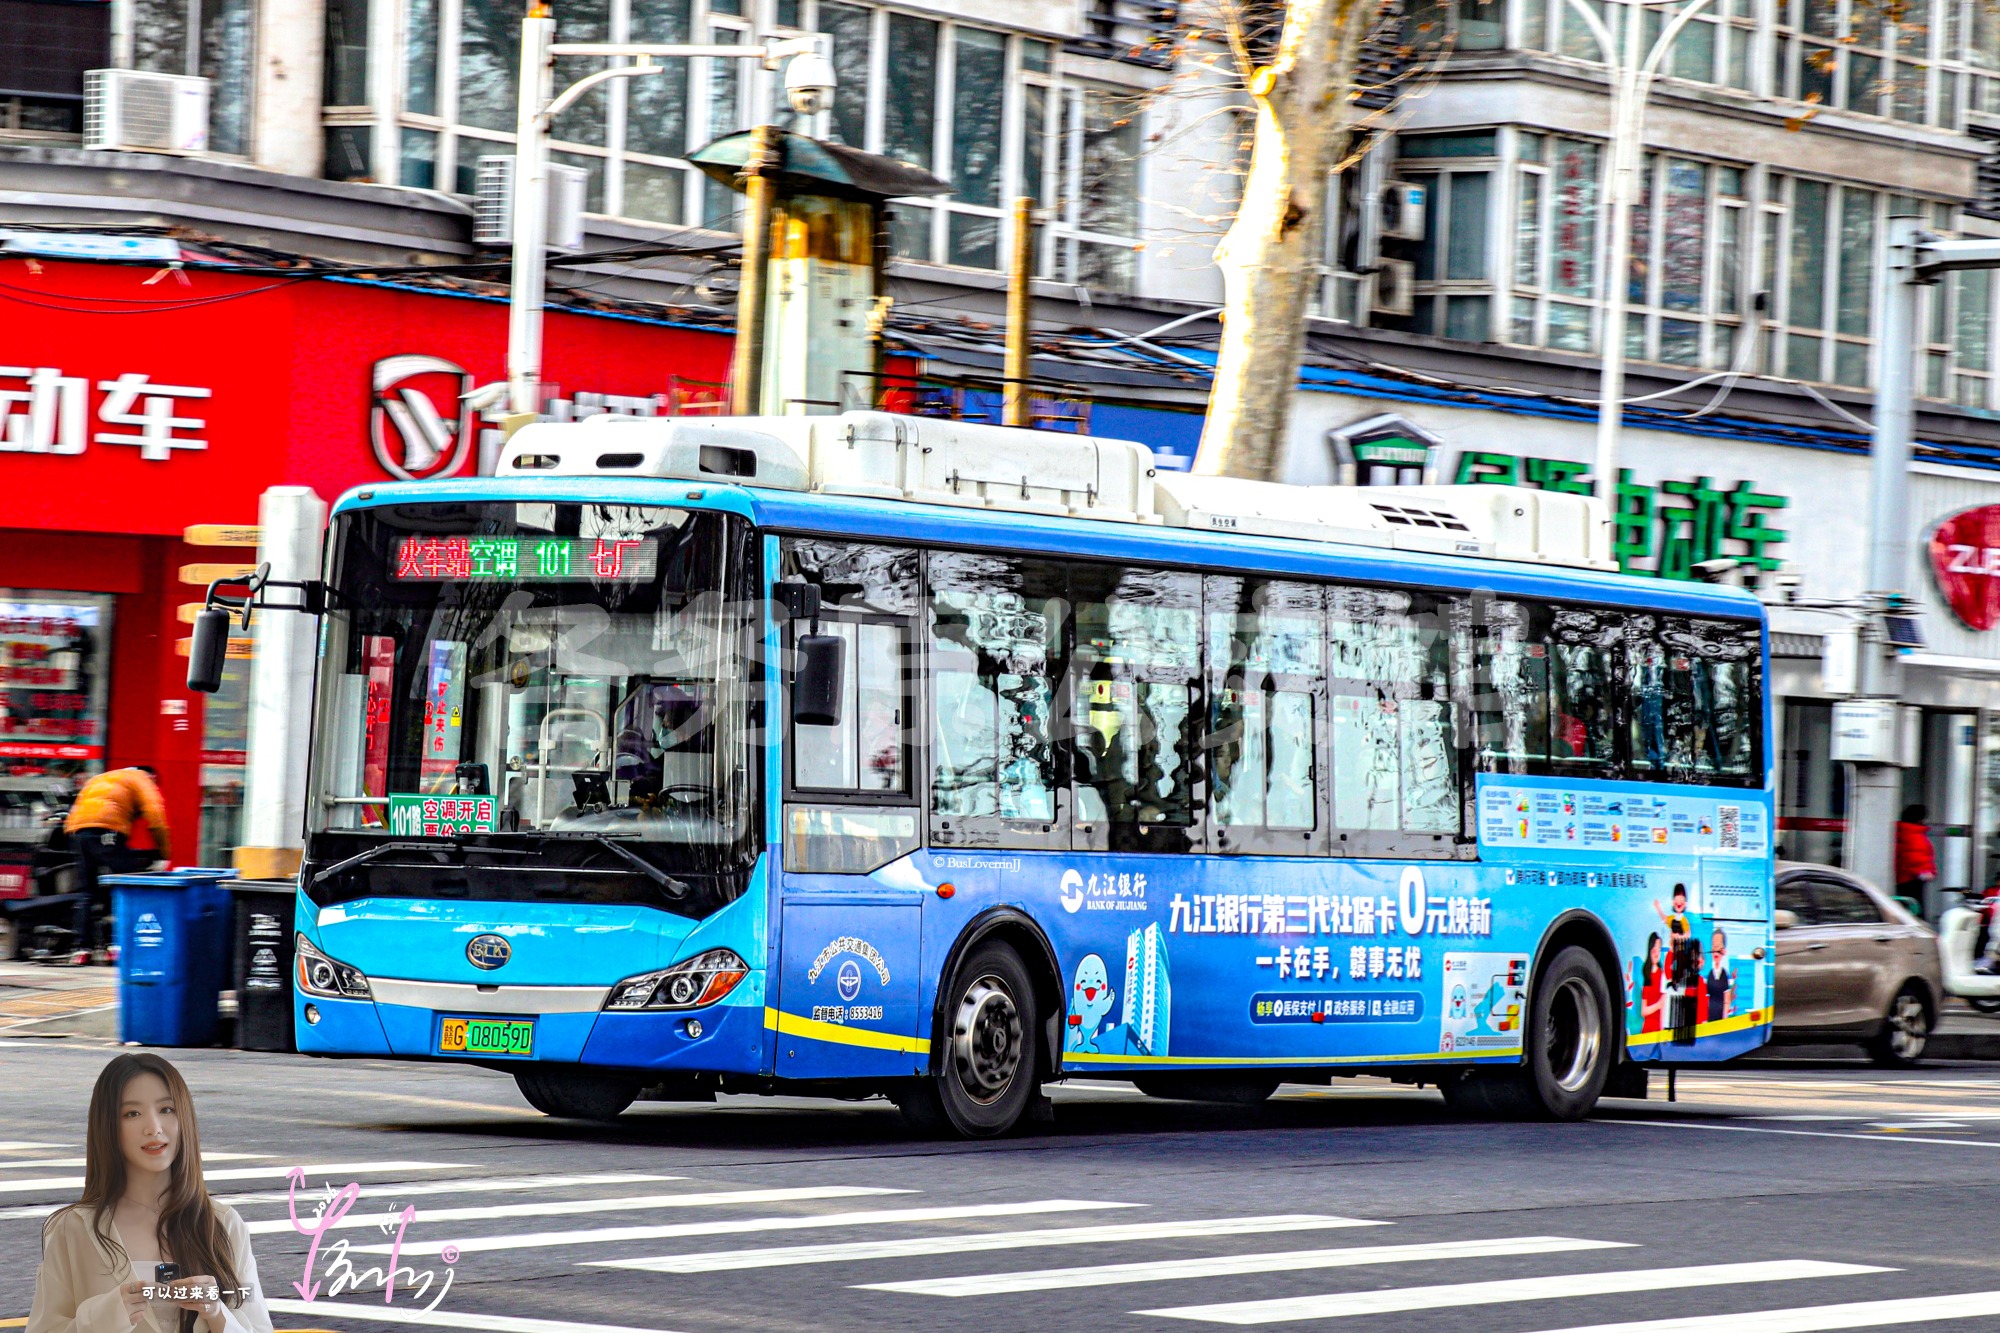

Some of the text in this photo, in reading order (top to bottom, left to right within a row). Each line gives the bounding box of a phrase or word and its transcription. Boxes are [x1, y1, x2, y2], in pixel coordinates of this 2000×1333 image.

[537, 541, 571, 576] 101
[422, 799, 493, 821] 空调开启
[1086, 872, 1148, 898] 九江银行
[1086, 900, 1148, 911] BANK OF JIUJIANG
[807, 936, 890, 986] 九江市公共交通集团公司
[1283, 1000, 1316, 1016] 医保支付
[1333, 1000, 1366, 1016] 政务服务
[1383, 1000, 1415, 1016] 金融应用
